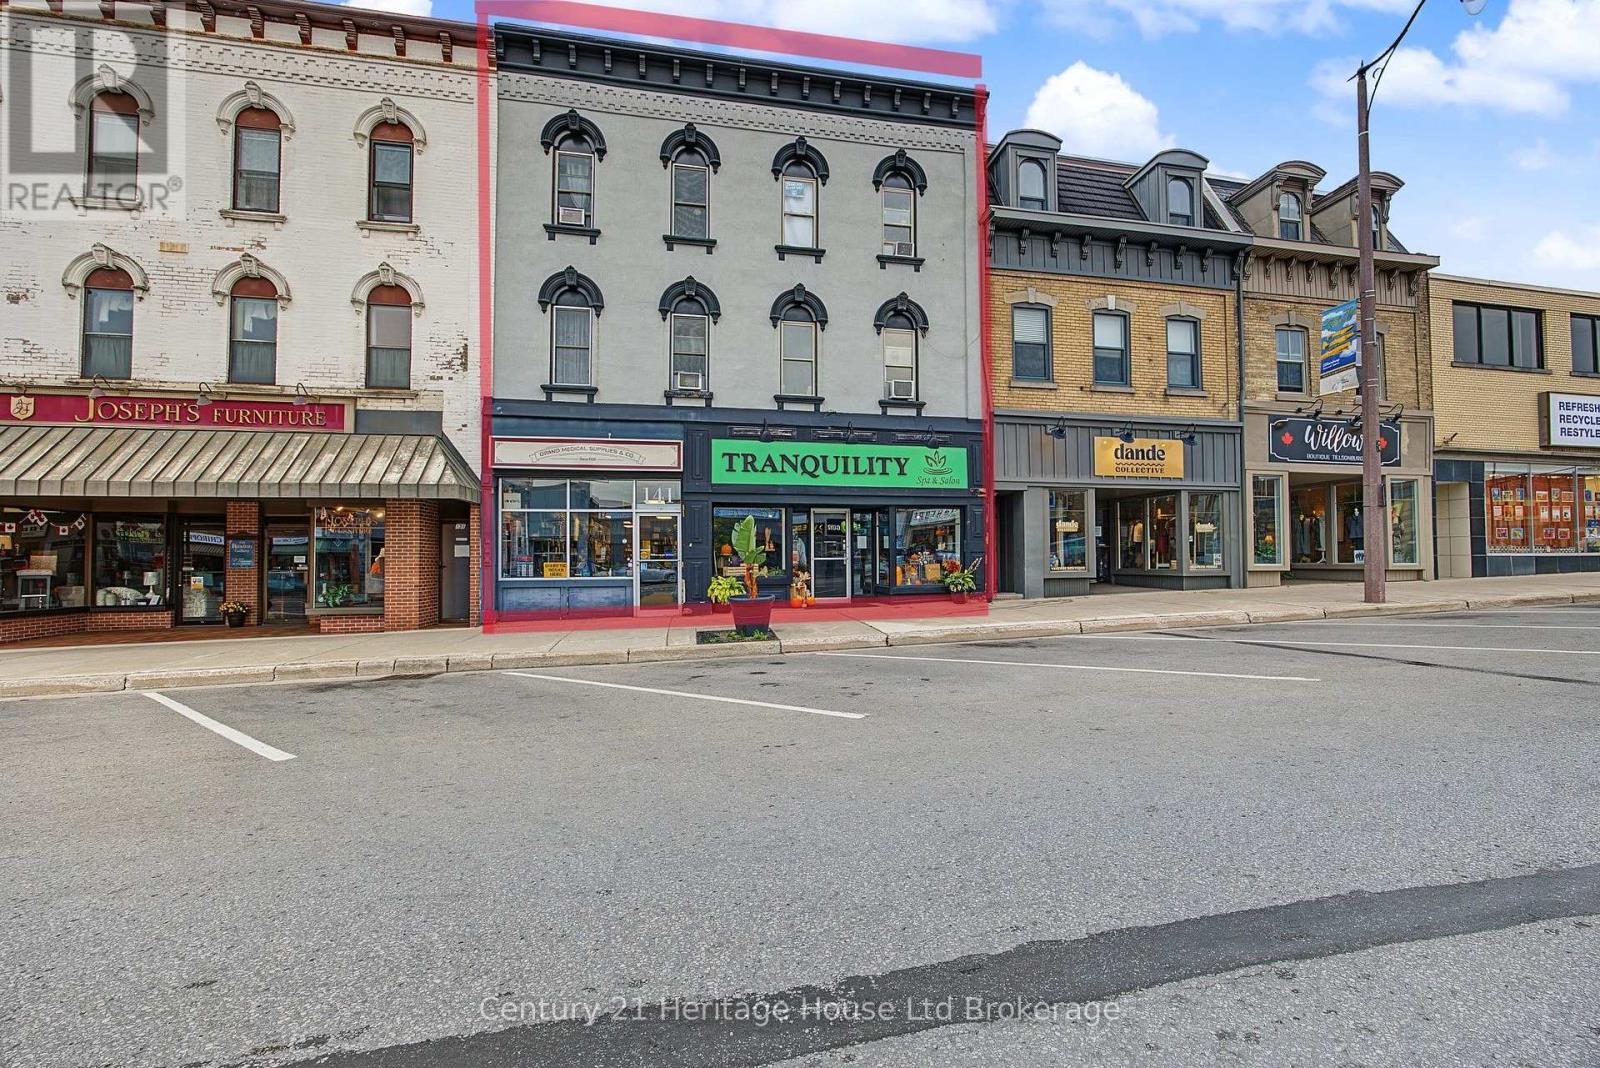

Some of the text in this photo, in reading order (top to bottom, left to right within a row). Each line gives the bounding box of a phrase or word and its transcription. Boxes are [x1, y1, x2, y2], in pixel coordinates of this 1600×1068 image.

[74, 394, 327, 426] JOSEPH'S FURNITURE
[1558, 401, 1600, 413] REFRESH
[1304, 424, 1363, 453] Willow
[589, 446, 618, 454] SUPPLIES
[1114, 443, 1166, 461] dande
[722, 453, 911, 478] TRANQUILITY
[1115, 466, 1165, 474] COLLECTIVE
[915, 475, 961, 486] Spa & Salon
[643, 487, 674, 504] 141
